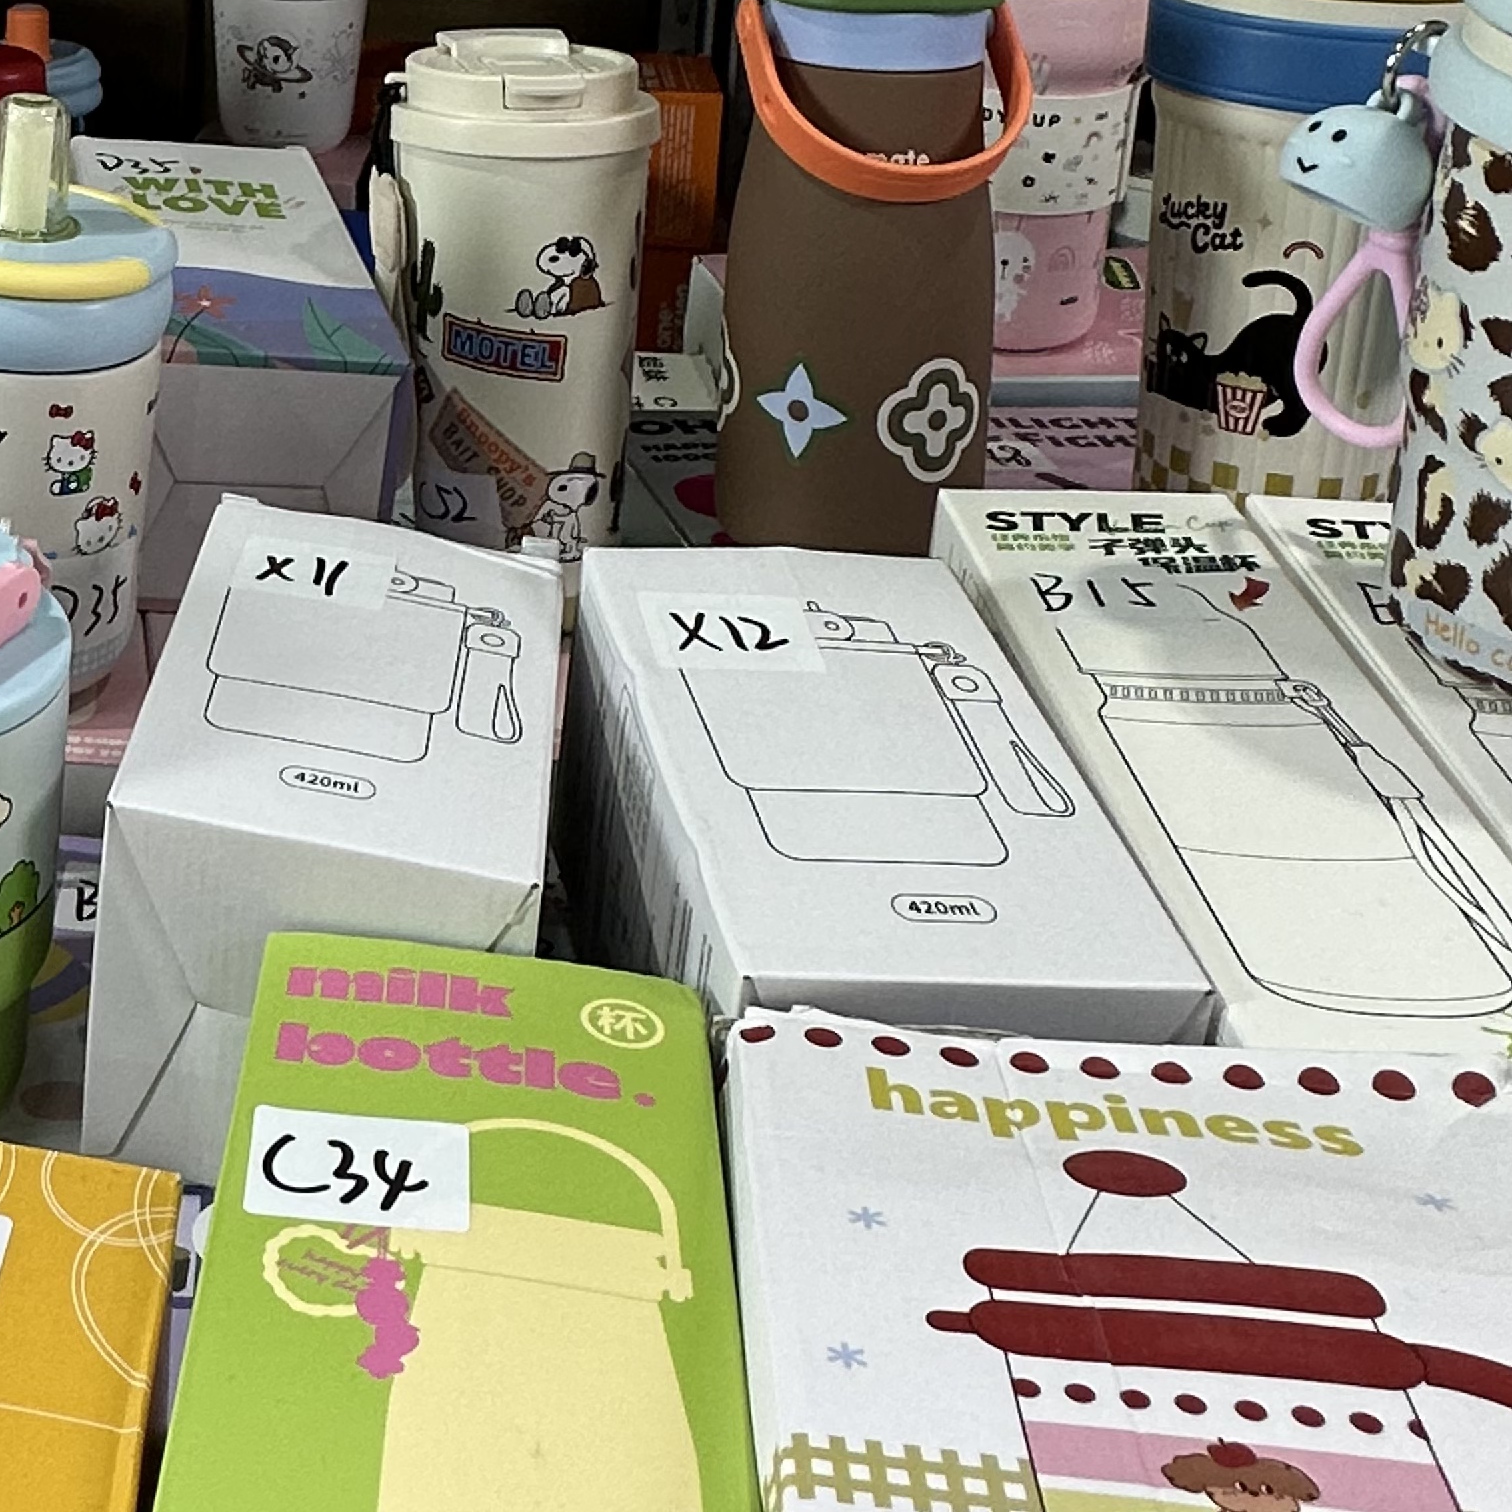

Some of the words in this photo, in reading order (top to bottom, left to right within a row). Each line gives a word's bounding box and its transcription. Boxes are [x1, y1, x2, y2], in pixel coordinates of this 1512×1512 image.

[1032, 111, 1062, 128] UP
[122, 175, 280, 202] WITH
[133, 192, 287, 221] LOVE
[1159, 192, 1227, 229] Lucky
[1191, 222, 1244, 254] Cat
[450, 327, 557, 372] MOTEL
[443, 422, 481, 476] BAIT
[985, 511, 1166, 534] STYLE
[293, 771, 361, 795] 420ml
[908, 898, 980, 918] 420ml
[286, 966, 516, 1020] milk
[595, 1004, 649, 1042] 杯
[865, 1065, 1365, 1158] happiness
[261, 1133, 430, 1212] C34
